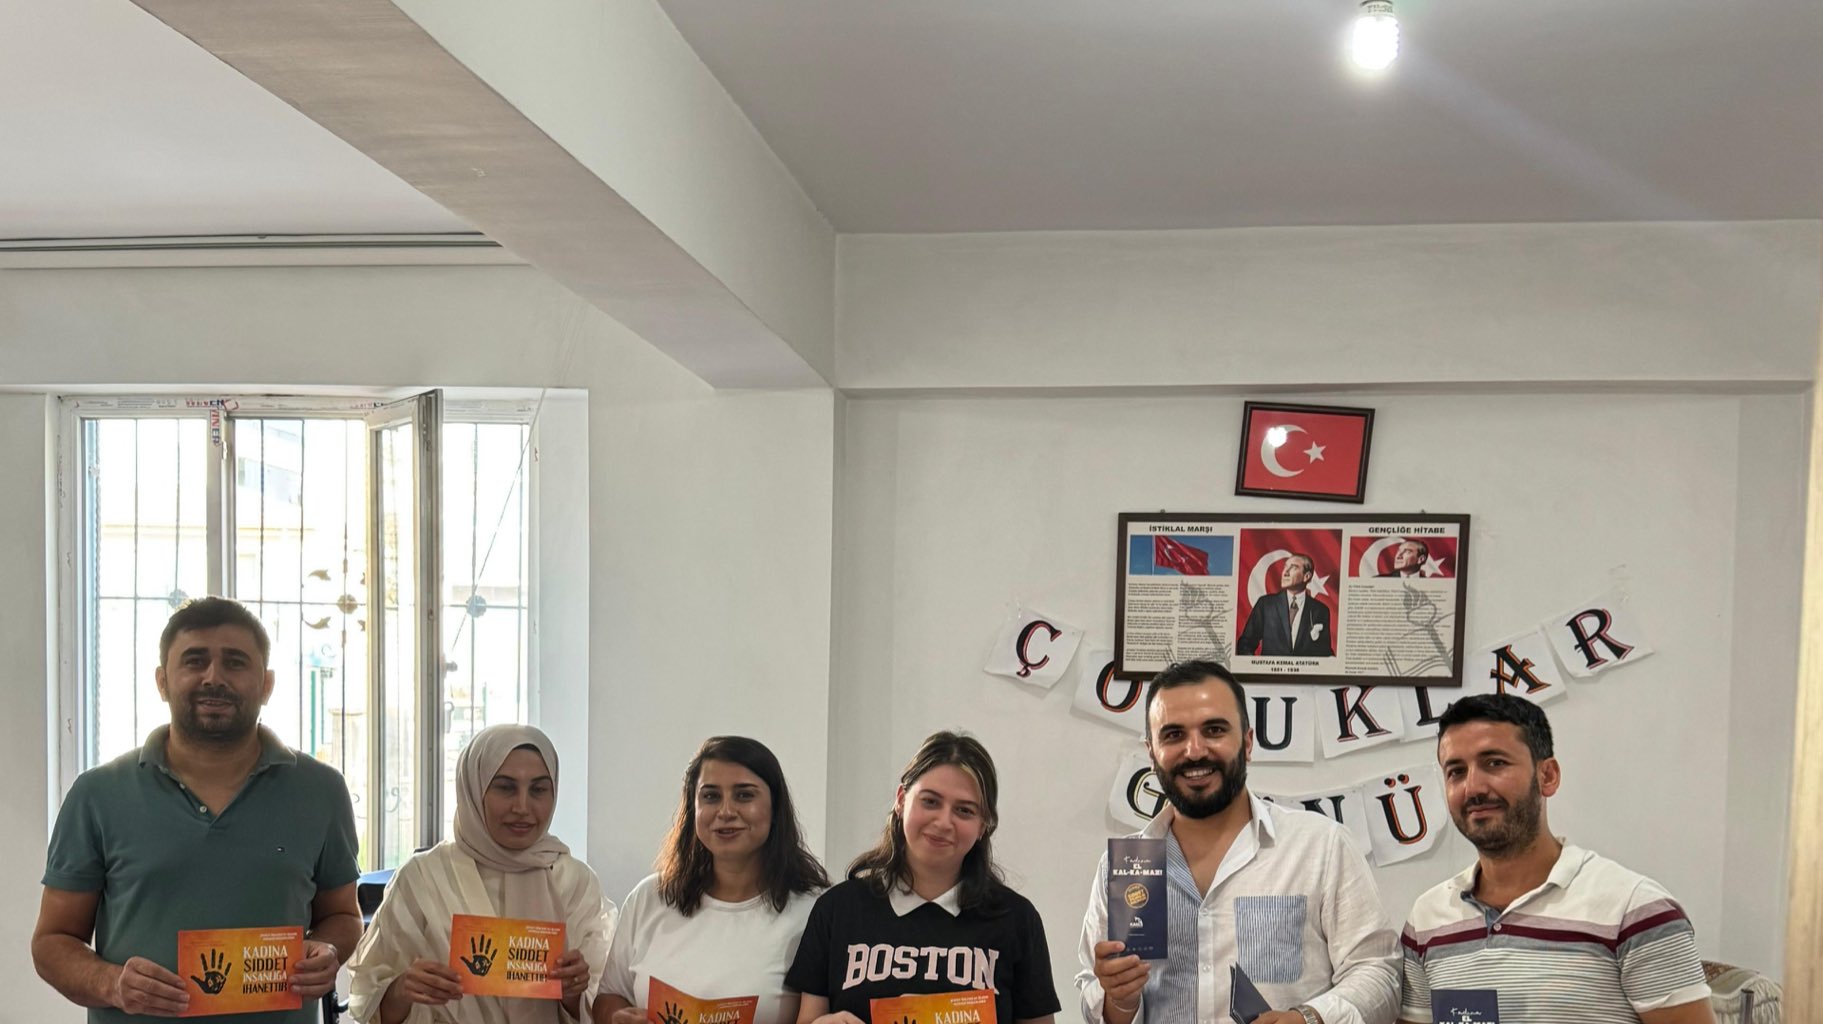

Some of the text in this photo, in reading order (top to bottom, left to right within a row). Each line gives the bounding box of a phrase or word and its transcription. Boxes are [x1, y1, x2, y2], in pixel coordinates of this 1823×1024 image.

[1149, 524, 1213, 534] İSTİKLAL MARŞI
[1368, 525, 1446, 535] GENÇLİĞE HİTABE
[508, 935, 550, 951] KADINA
[243, 944, 288, 959] KADINA
[842, 943, 1000, 995] BOSTON
[699, 1009, 741, 1024] KADINA
